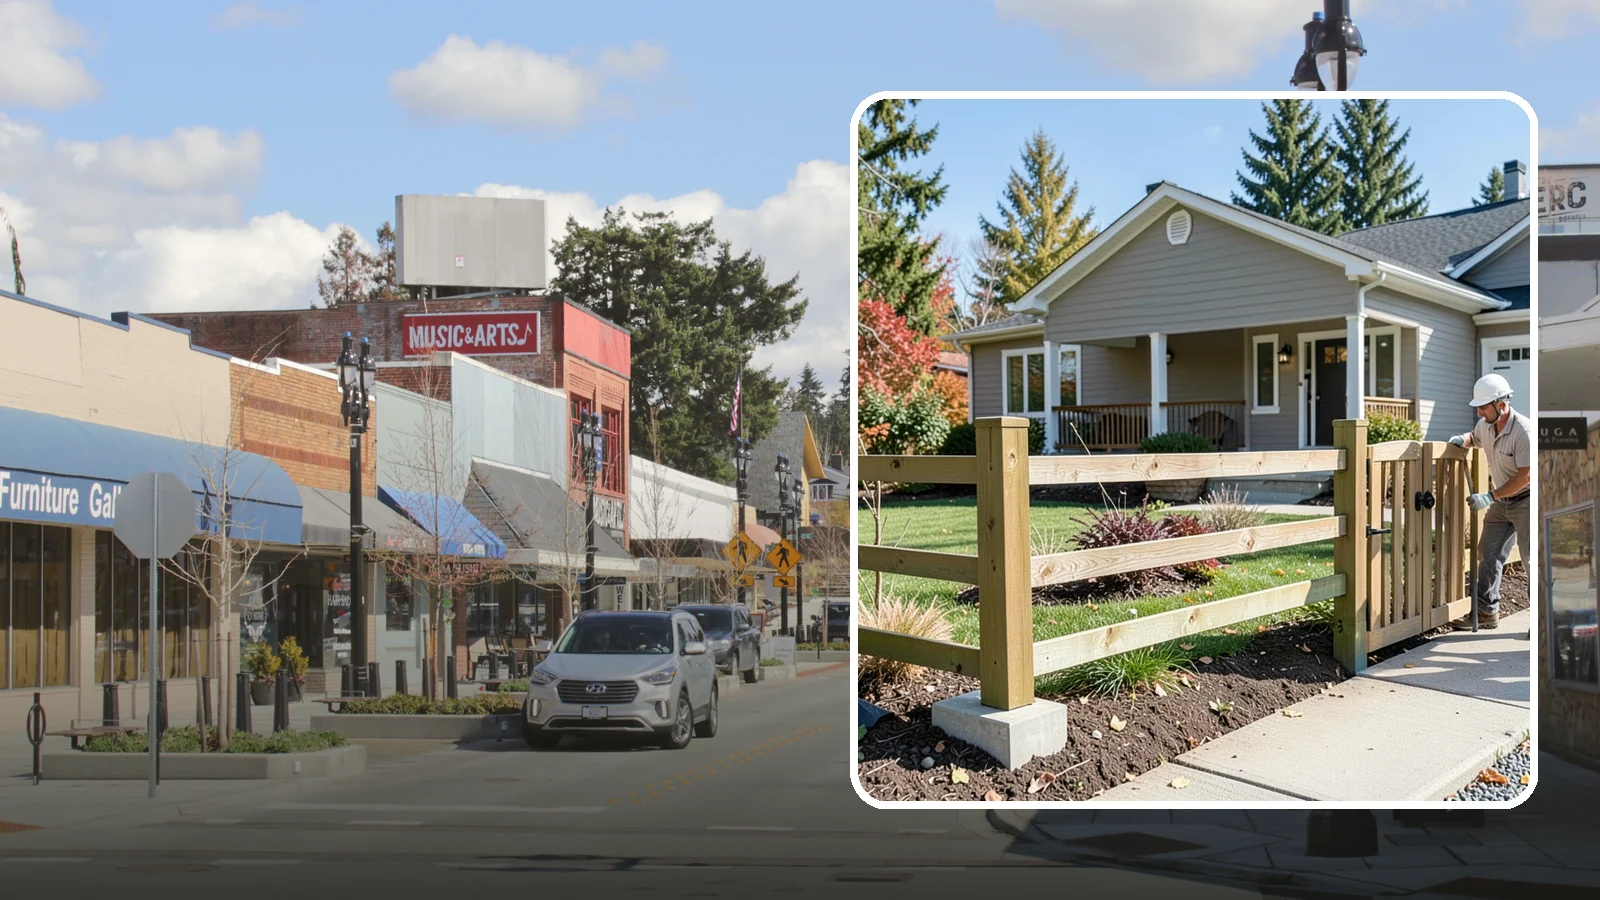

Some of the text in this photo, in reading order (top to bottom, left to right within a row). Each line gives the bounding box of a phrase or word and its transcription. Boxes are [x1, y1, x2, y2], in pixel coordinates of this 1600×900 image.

[408, 323, 520, 348] MUSIC&ARTS
[0, 471, 80, 515] Furniture
[453, 563, 479, 574] SUSHI
